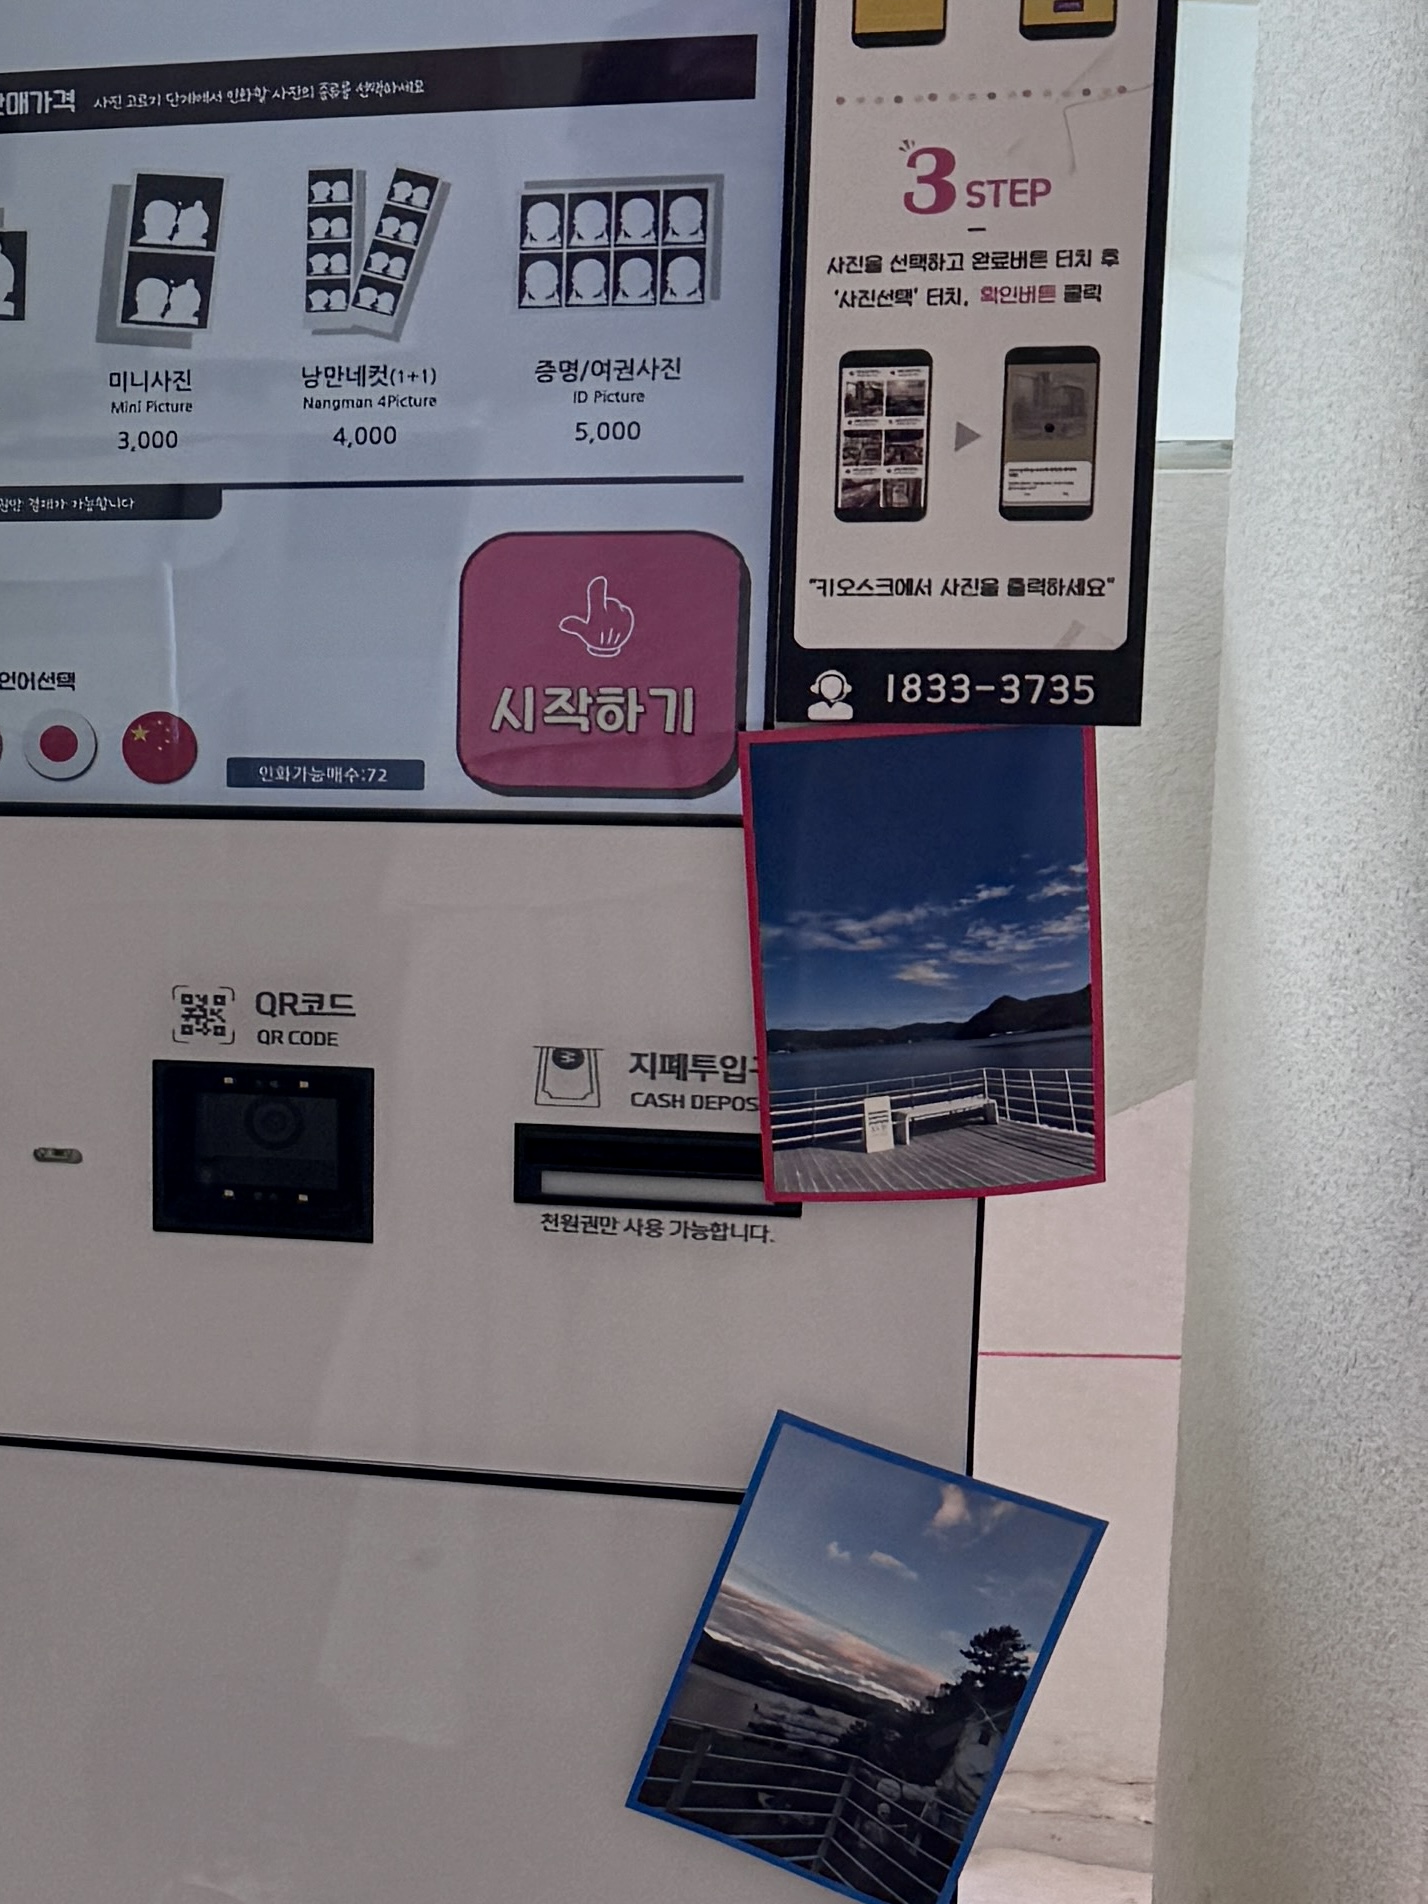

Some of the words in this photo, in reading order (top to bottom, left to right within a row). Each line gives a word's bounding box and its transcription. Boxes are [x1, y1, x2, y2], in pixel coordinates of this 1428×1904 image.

[93, 94, 123, 110] 사진
[903, 146, 957, 216] 3
[965, 177, 1052, 209] STEP
[827, 254, 883, 275] 사진을
[889, 252, 964, 273] 선택하고
[971, 249, 1048, 271] 완료버튼
[1055, 248, 1093, 268] 터치
[1100, 248, 1120, 268] 후
[980, 284, 1056, 305] 확인버튼
[1063, 283, 1102, 303] 클릭
[108, 369, 193, 394] 미니사진
[301, 364, 437, 388] 낭만네컷(1+1)
[534, 356, 682, 384] 증명/여권사진
[110, 400, 143, 415] Mini
[146, 399, 193, 413] Picture
[302, 396, 373, 412] Nangman
[377, 394, 437, 408] 4Picture
[572, 390, 589, 404] ID
[593, 389, 645, 404] Picture
[117, 430, 179, 453] 3,000
[332, 426, 398, 448] 4,000
[574, 420, 642, 445] 5,000
[940, 577, 999, 598] 사진을
[886, 673, 1096, 705] 1833-3735
[490, 686, 695, 735] 시작하기
[258, 765, 389, 784] 인화가능매수:72
[254, 991, 357, 1018] QR코드
[256, 1029, 285, 1047] QR
[289, 1029, 339, 1048] CODE
[630, 1092, 685, 1110] CASH
[540, 1212, 619, 1235] 천원권만
[623, 1216, 664, 1238] 사용
[669, 1219, 776, 1244] 가능합니다.
